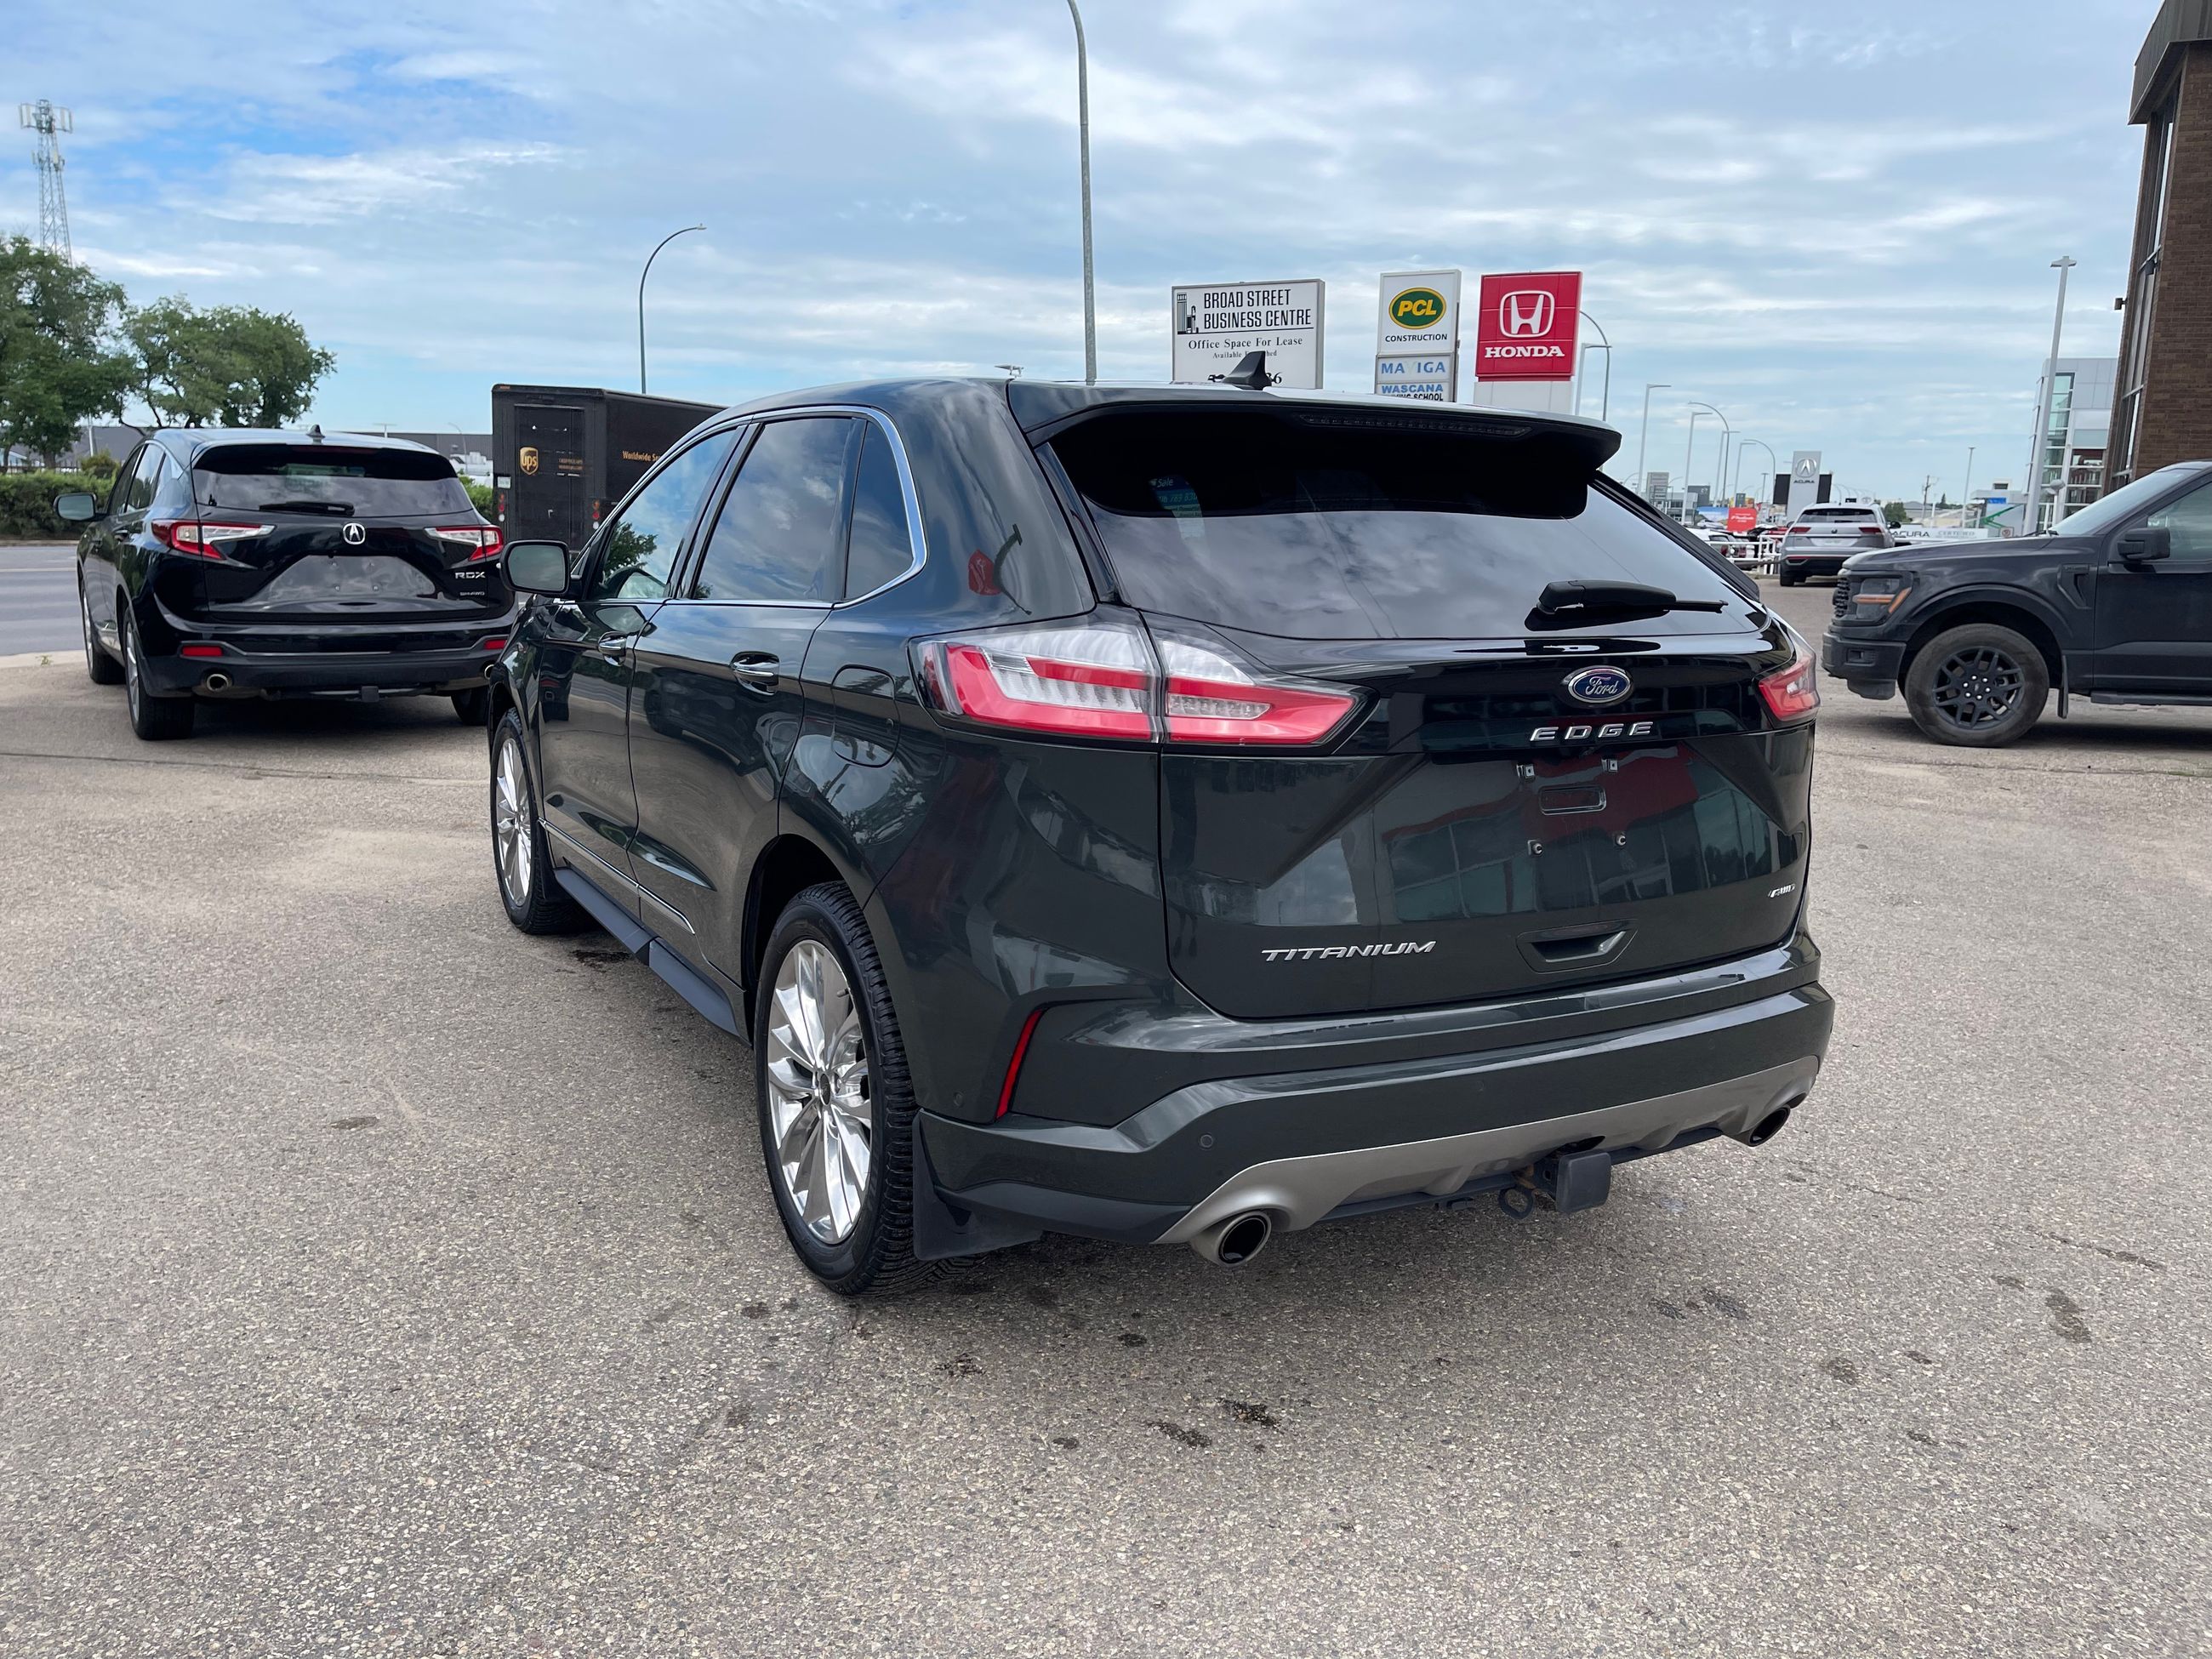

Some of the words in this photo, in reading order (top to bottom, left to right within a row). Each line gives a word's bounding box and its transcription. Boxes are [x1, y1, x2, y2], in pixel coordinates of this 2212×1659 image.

[1204, 291, 1244, 309] BROAD
[1247, 289, 1291, 307] STREET
[1397, 299, 1437, 316] PCL
[1204, 311, 1262, 329] BUSINESS
[1265, 309, 1311, 327] CENTRE
[1189, 339, 1220, 350] Office
[1224, 339, 1251, 350] Space
[1256, 338, 1272, 347] For
[1276, 337, 1303, 346] Lease
[1385, 334, 1448, 342] CONSTRUCTION
[1485, 346, 1565, 358] HONDA
[1382, 384, 1444, 394] WASCANA
[1413, 393, 1444, 402] SCHOOL
[622, 451, 652, 462] Worldwide
[454, 571, 486, 579] RDX
[1585, 676, 1619, 696] Ford
[1530, 721, 1654, 742] EDGE
[1261, 941, 1437, 961] TITANIUM
